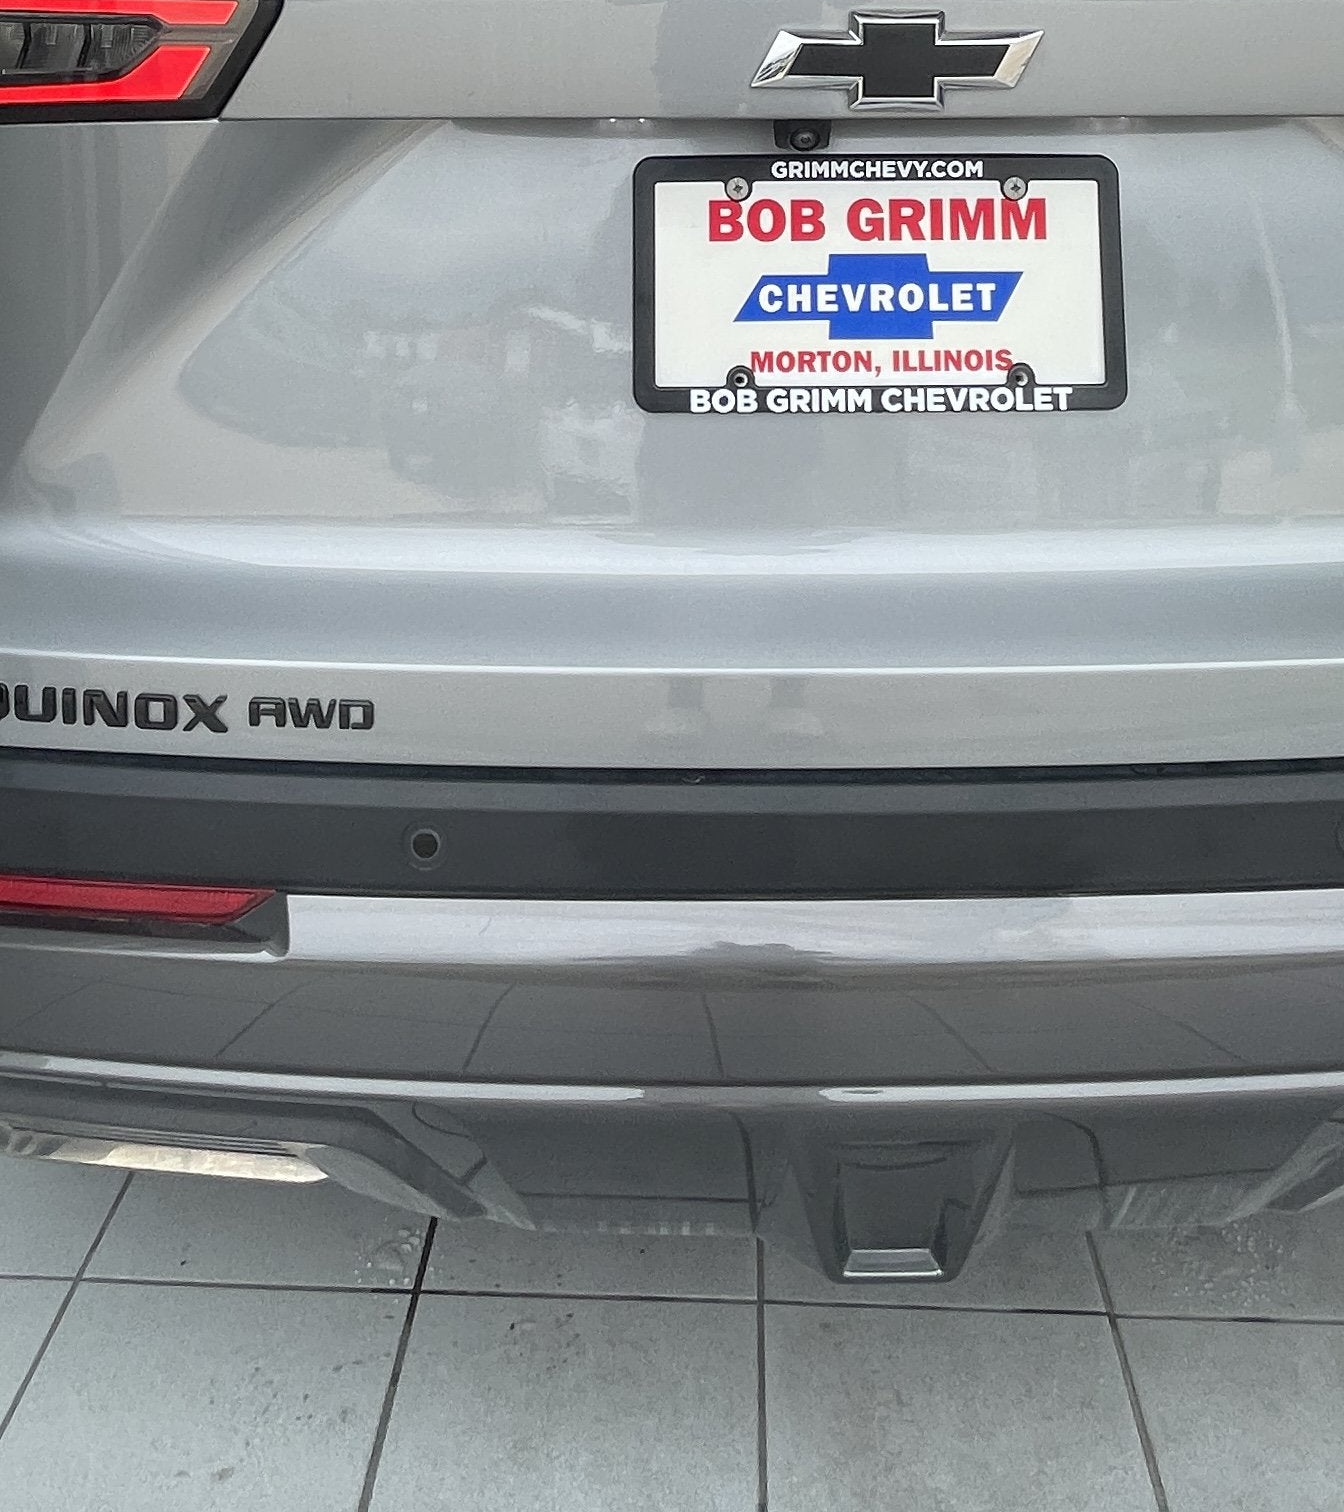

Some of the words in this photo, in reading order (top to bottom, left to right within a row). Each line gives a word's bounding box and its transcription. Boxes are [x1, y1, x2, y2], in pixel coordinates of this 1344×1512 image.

[771, 160, 984, 179] GRIMMCHEVY.COM
[709, 198, 826, 242] BOB
[846, 198, 1047, 241] GRIMM
[758, 283, 997, 313] CHEVROLET
[750, 350, 882, 378] MORTON,
[892, 349, 1014, 372] ILLINOIS
[689, 389, 758, 414] BOB
[766, 388, 873, 413] GRIMM
[882, 387, 1074, 412] CHEVROLET
[248, 696, 375, 730] AWD
